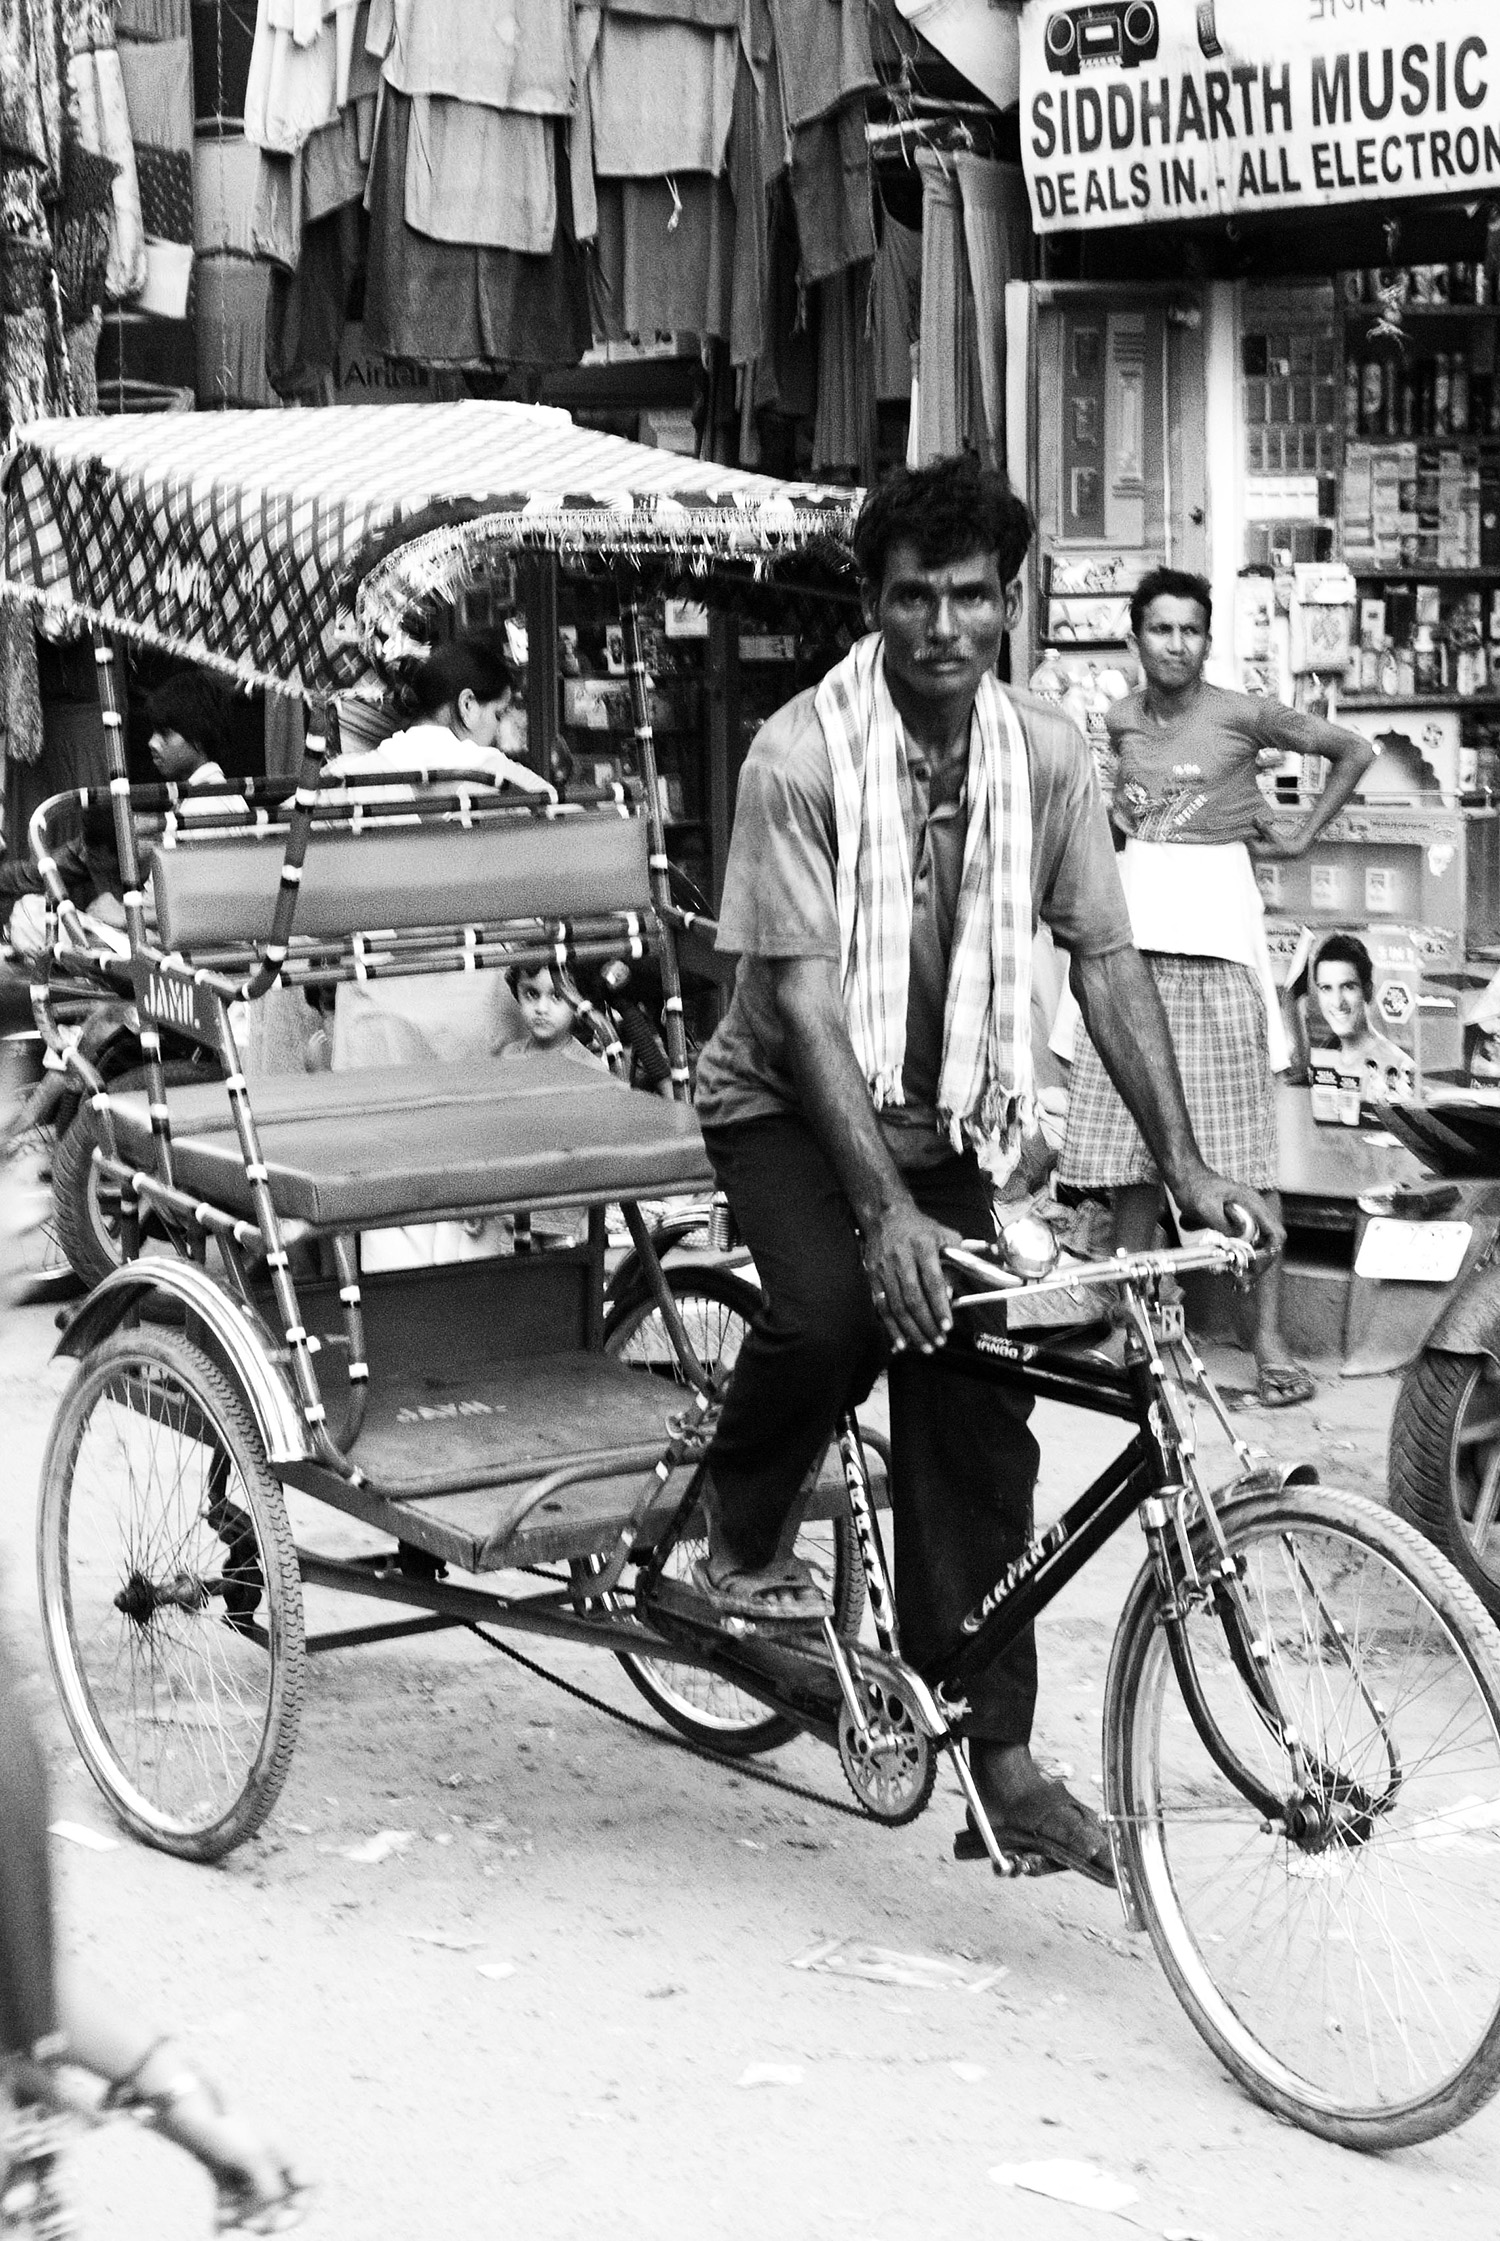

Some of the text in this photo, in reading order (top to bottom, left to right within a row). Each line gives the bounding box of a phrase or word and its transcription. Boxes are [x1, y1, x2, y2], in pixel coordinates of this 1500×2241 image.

[1031, 35, 1489, 159] SIDDHARTH MUSIC
[1034, 162, 1151, 219] DEALS
[1237, 147, 1302, 199] ALL
